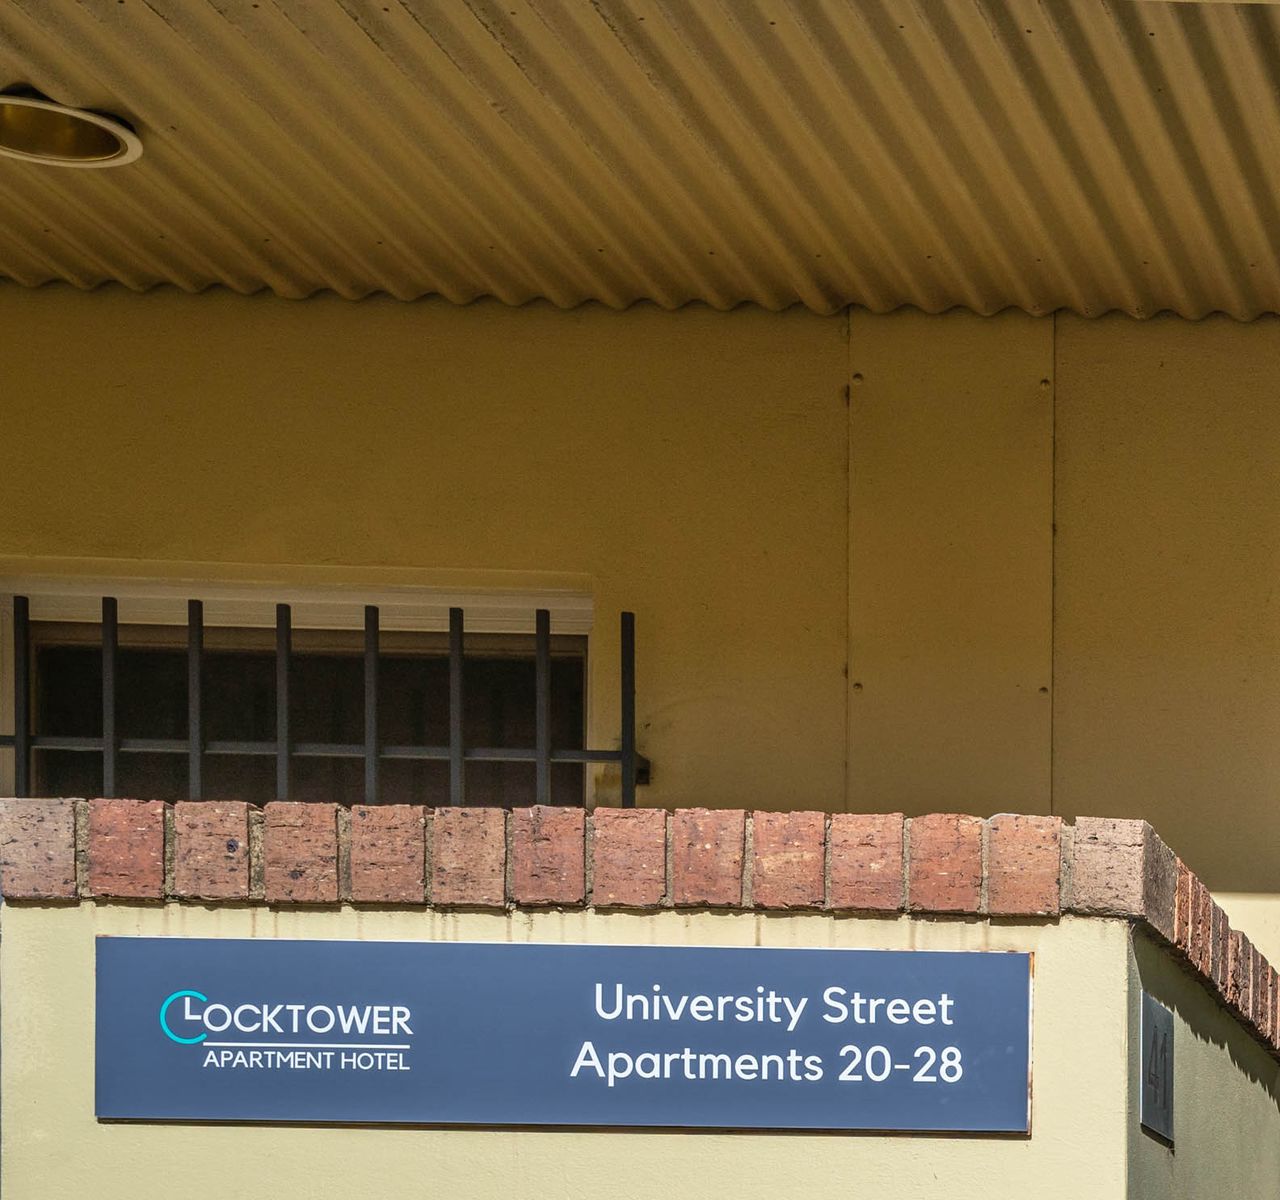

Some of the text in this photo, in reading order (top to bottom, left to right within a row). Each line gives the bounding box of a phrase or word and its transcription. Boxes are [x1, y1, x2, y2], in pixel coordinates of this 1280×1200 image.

[159, 990, 414, 1044] CLOCKTOWER
[595, 983, 954, 1031] University Street
[203, 1050, 410, 1070] APARTMENT HOTEL
[570, 1041, 963, 1086] Apartments 20-28
